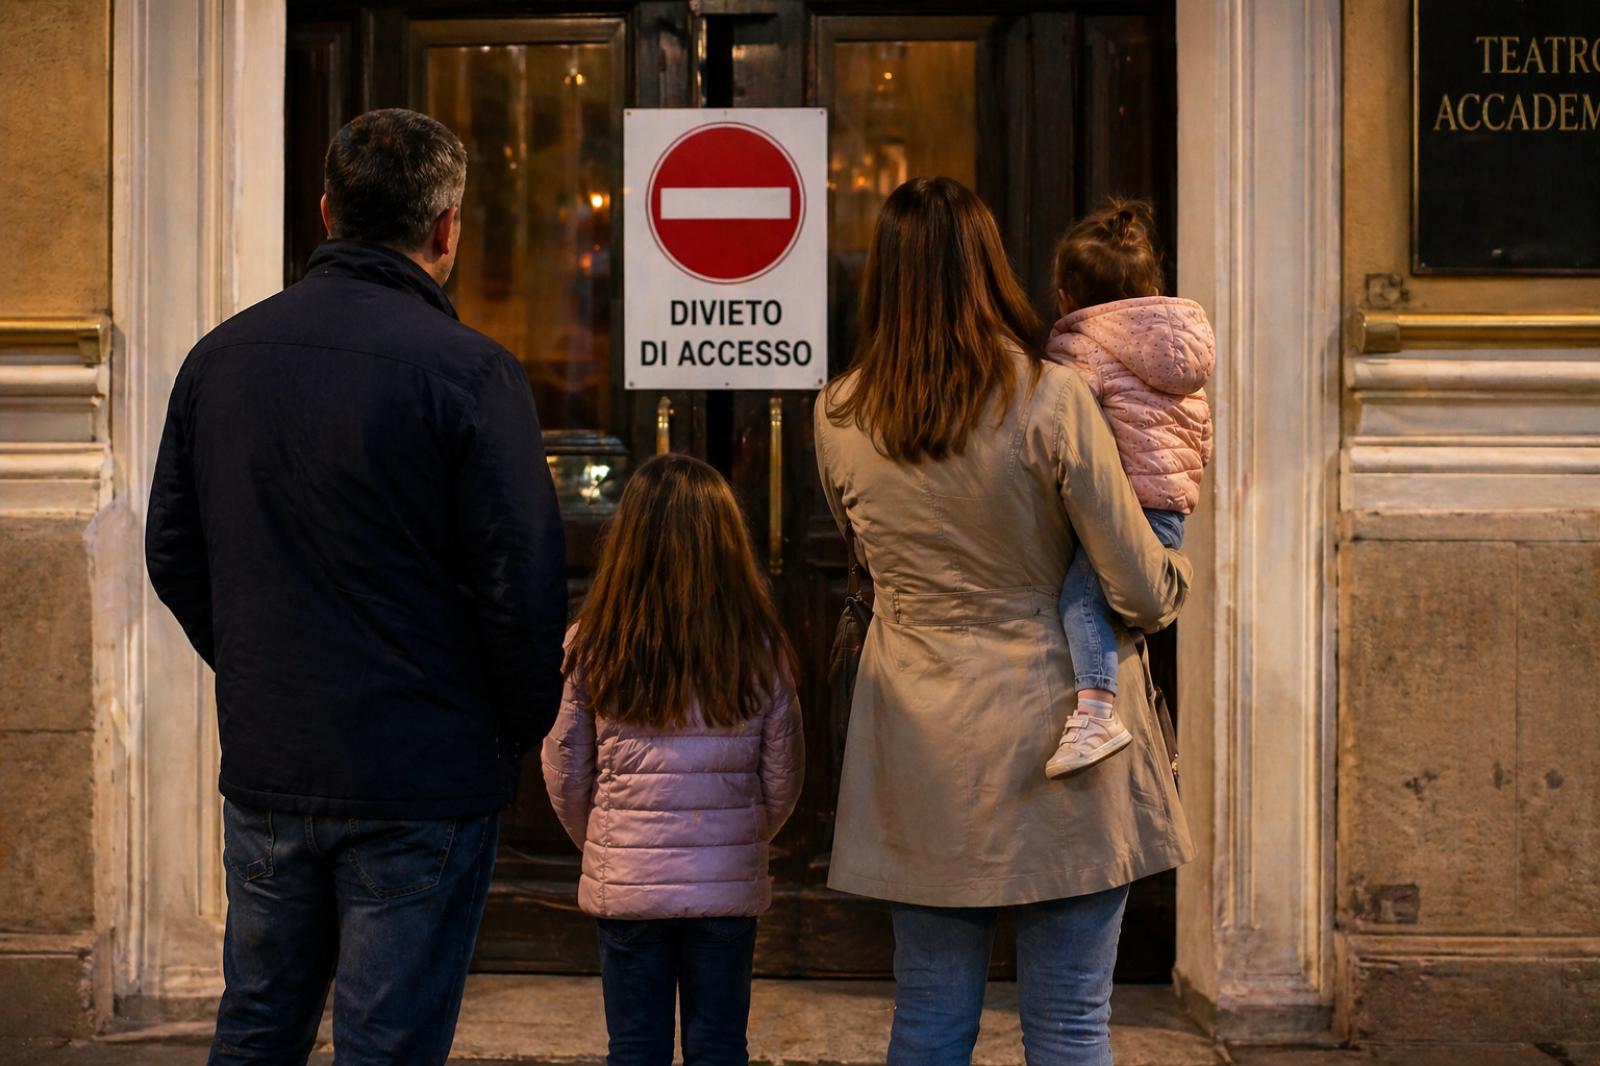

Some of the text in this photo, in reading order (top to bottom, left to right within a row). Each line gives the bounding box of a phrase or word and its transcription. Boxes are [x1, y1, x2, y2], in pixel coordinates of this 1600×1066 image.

[1475, 36, 1600, 74] TEATR
[670, 299, 783, 326] DIVIETO
[640, 339, 812, 367] DI ACCESSO
